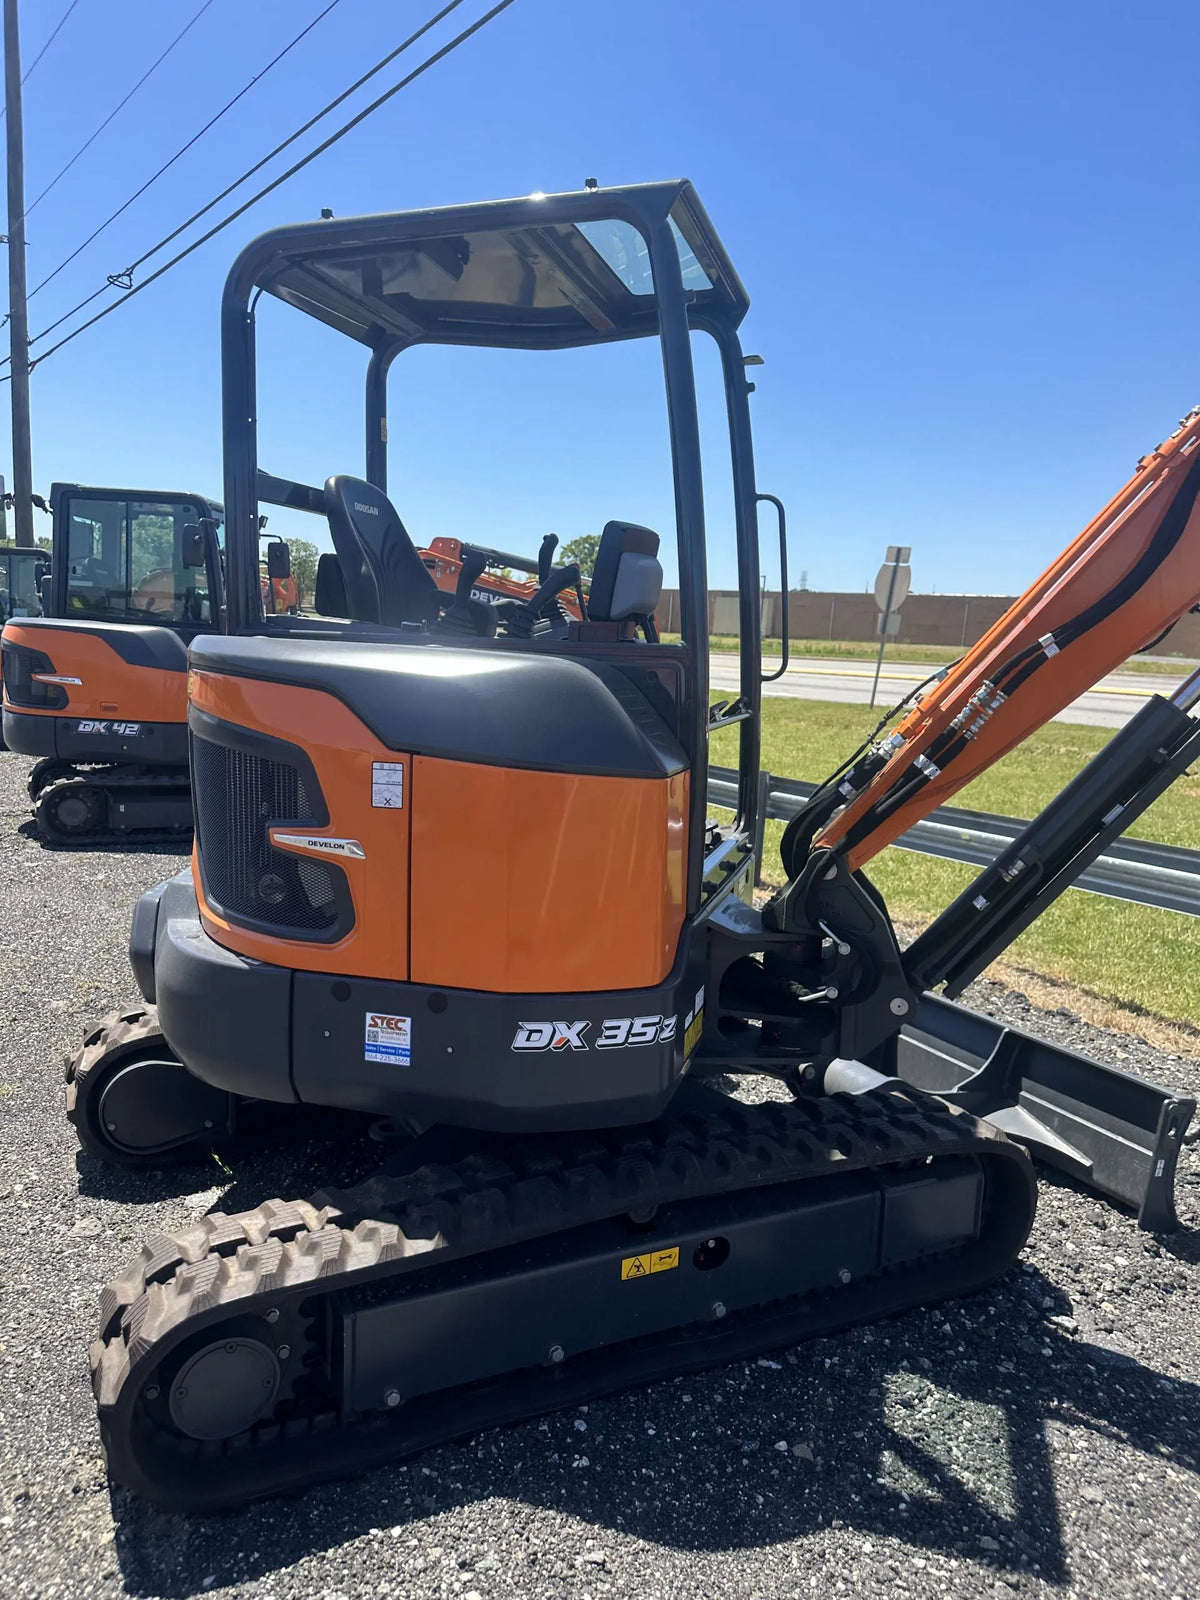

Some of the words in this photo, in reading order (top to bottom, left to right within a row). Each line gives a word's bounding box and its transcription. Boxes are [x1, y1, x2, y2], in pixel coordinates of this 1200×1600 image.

[354, 502, 379, 516] DOOSAN
[78, 720, 109, 735] DX
[112, 722, 140, 736] 42
[308, 840, 345, 849] DEVELON
[368, 1015, 407, 1031] STEC
[511, 1020, 592, 1052] DX
